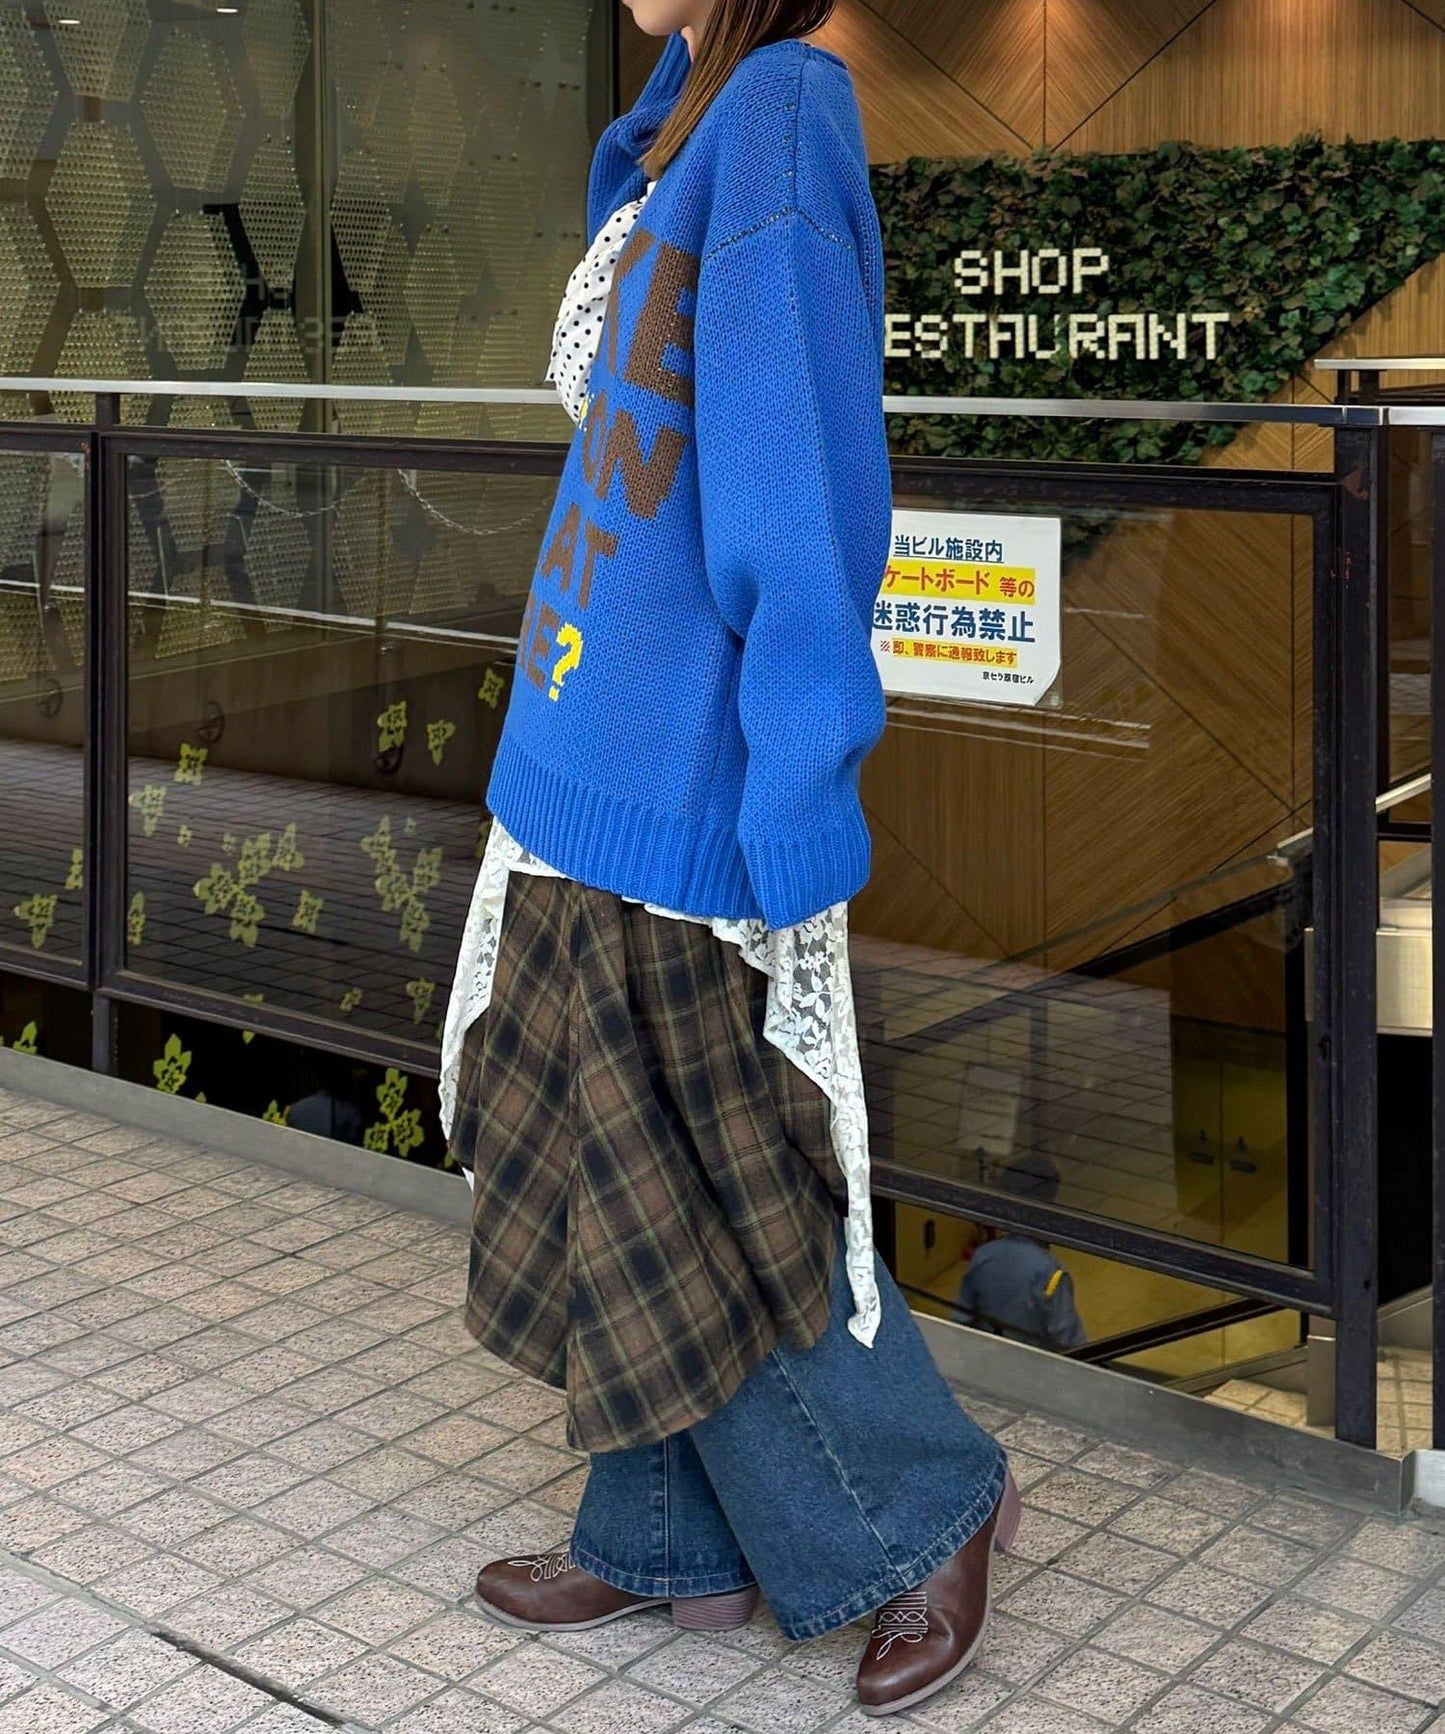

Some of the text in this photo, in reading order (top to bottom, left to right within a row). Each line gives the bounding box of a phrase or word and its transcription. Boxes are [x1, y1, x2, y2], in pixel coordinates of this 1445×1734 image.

[954, 248, 1109, 295] SHOP
[884, 312, 1230, 360] ESTAURANT
[894, 534, 1004, 562] 当ビル施設内
[884, 564, 1035, 598] ケートボード 等の
[873, 600, 1036, 643] 迷惑行為禁止
